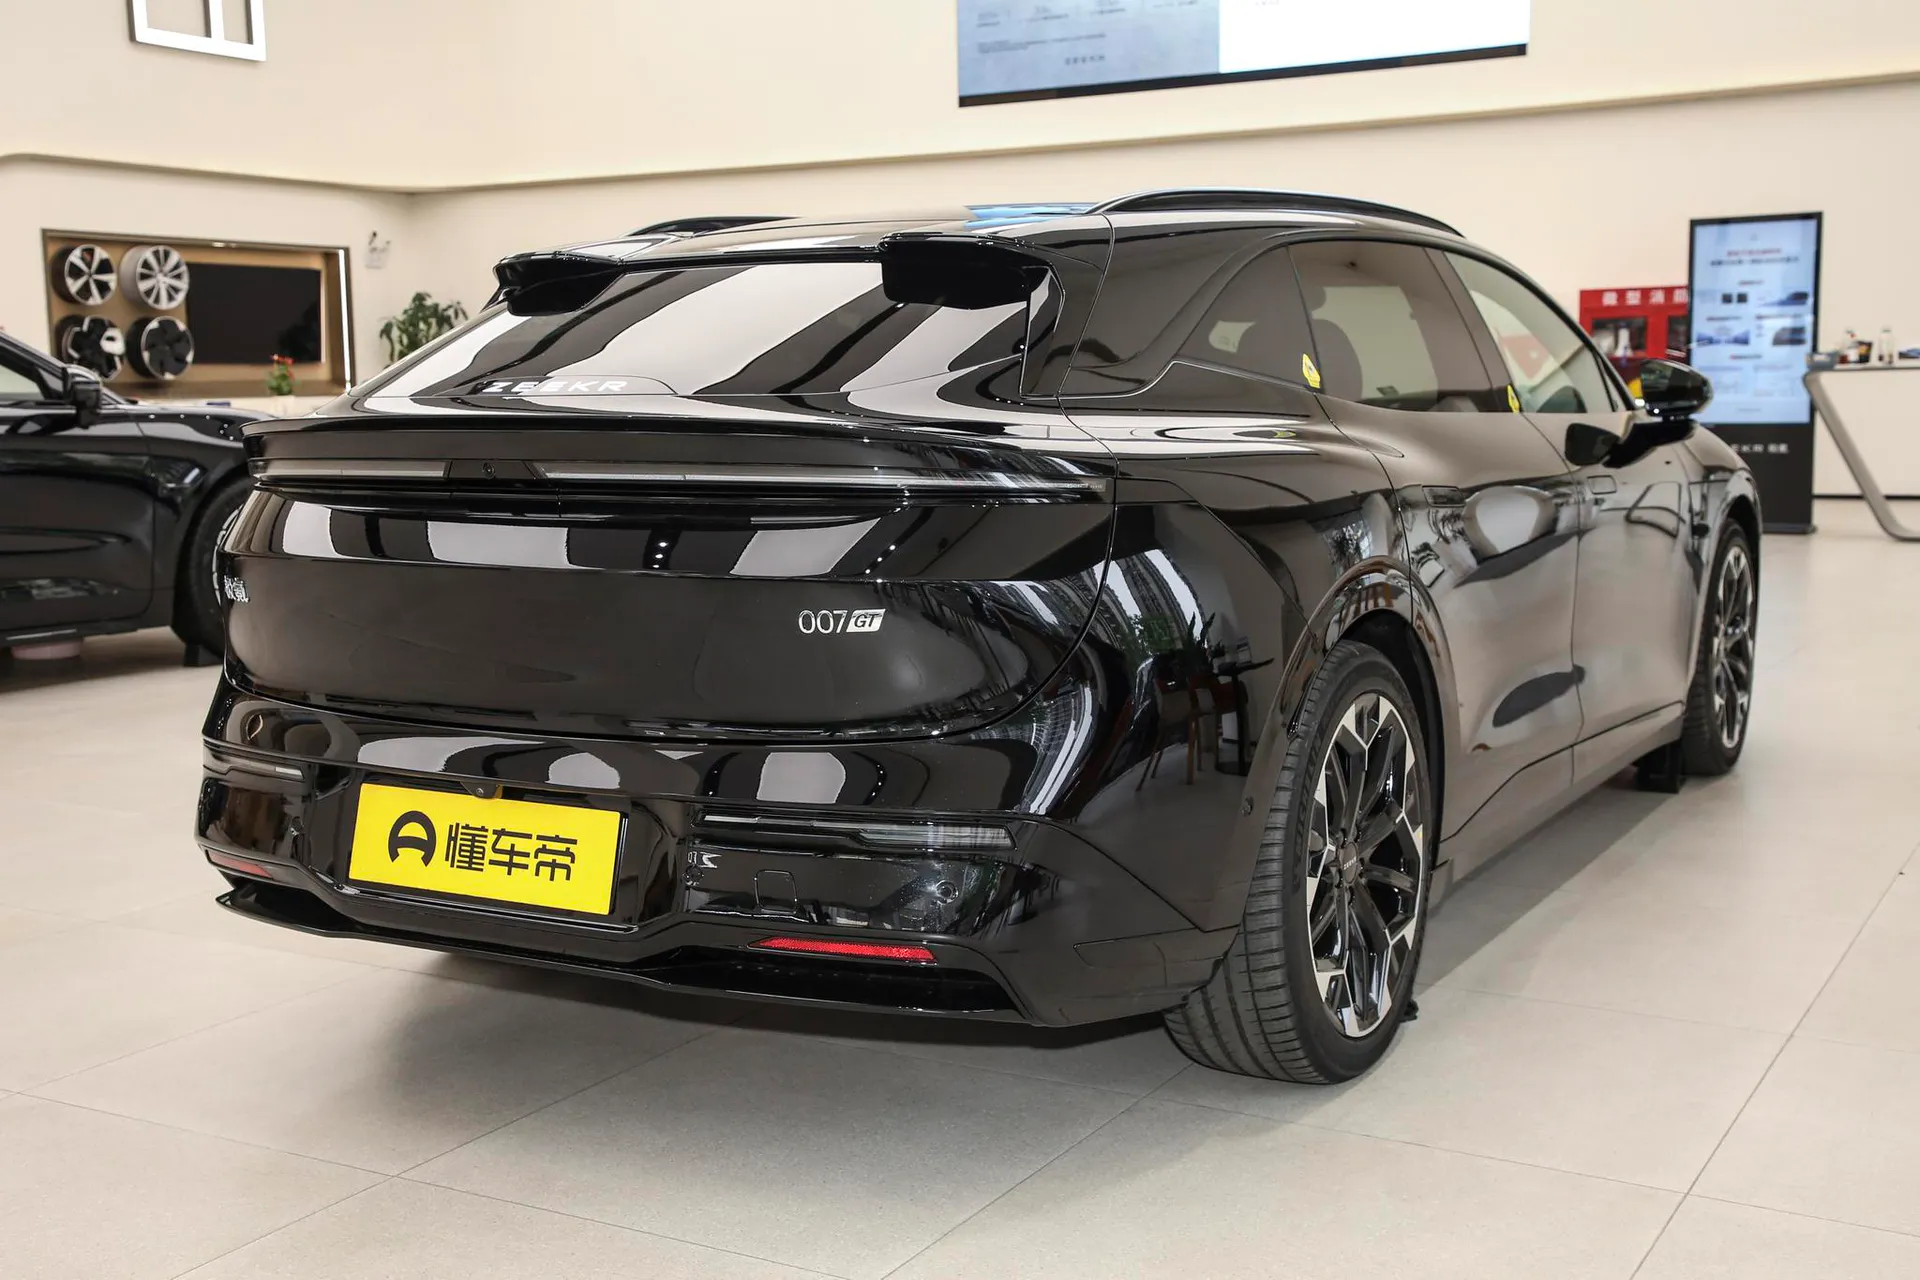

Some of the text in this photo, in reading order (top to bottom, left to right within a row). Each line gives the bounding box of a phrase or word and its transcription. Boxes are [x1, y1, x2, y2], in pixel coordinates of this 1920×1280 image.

[481, 380, 628, 393] ZEEKR
[798, 609, 884, 634] 007 GT
[444, 821, 579, 882] 懂车帝
